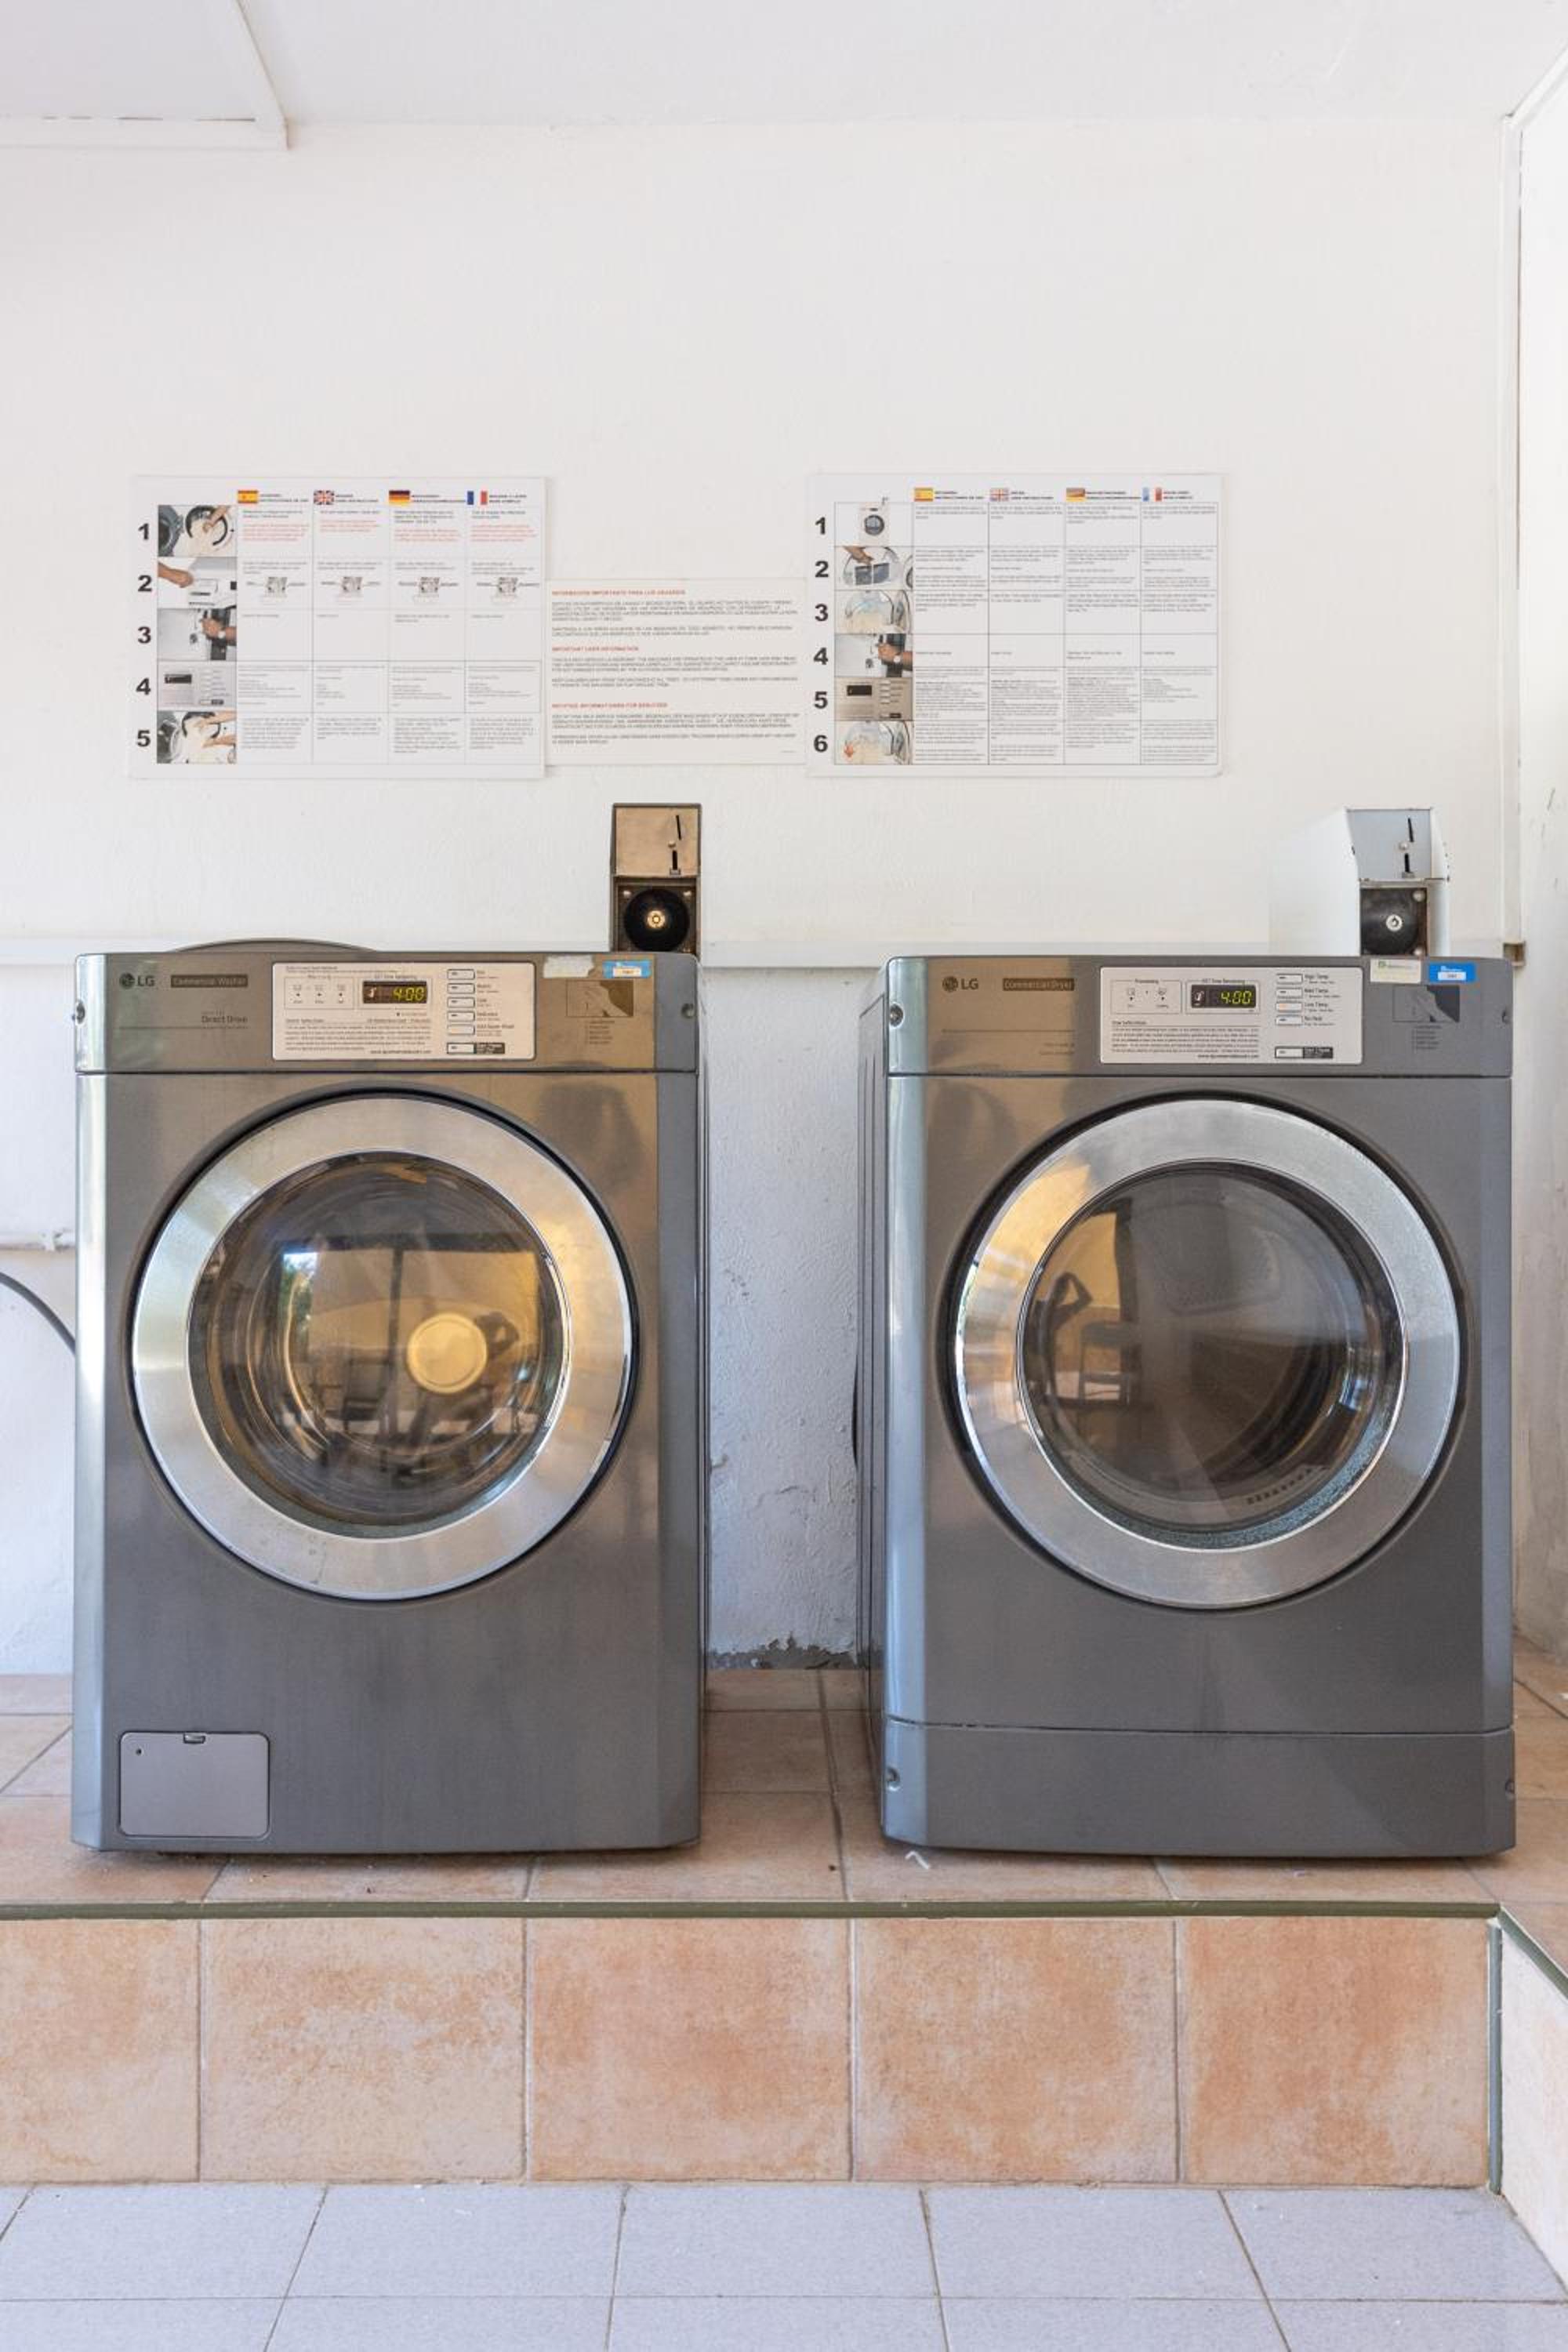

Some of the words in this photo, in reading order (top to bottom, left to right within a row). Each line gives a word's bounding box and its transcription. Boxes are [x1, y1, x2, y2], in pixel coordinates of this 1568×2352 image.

[138, 523, 149, 540] 1
[815, 517, 826, 535] 1
[815, 560, 829, 578] 2
[137, 575, 153, 593] 2
[815, 603, 829, 622] 3
[137, 626, 151, 644] 3
[813, 647, 829, 666] 4
[136, 677, 151, 695] 4
[814, 691, 829, 710] 5
[137, 729, 151, 747] 5
[813, 735, 829, 753] 6
[137, 975, 155, 986] LG
[961, 978, 978, 989] LG
